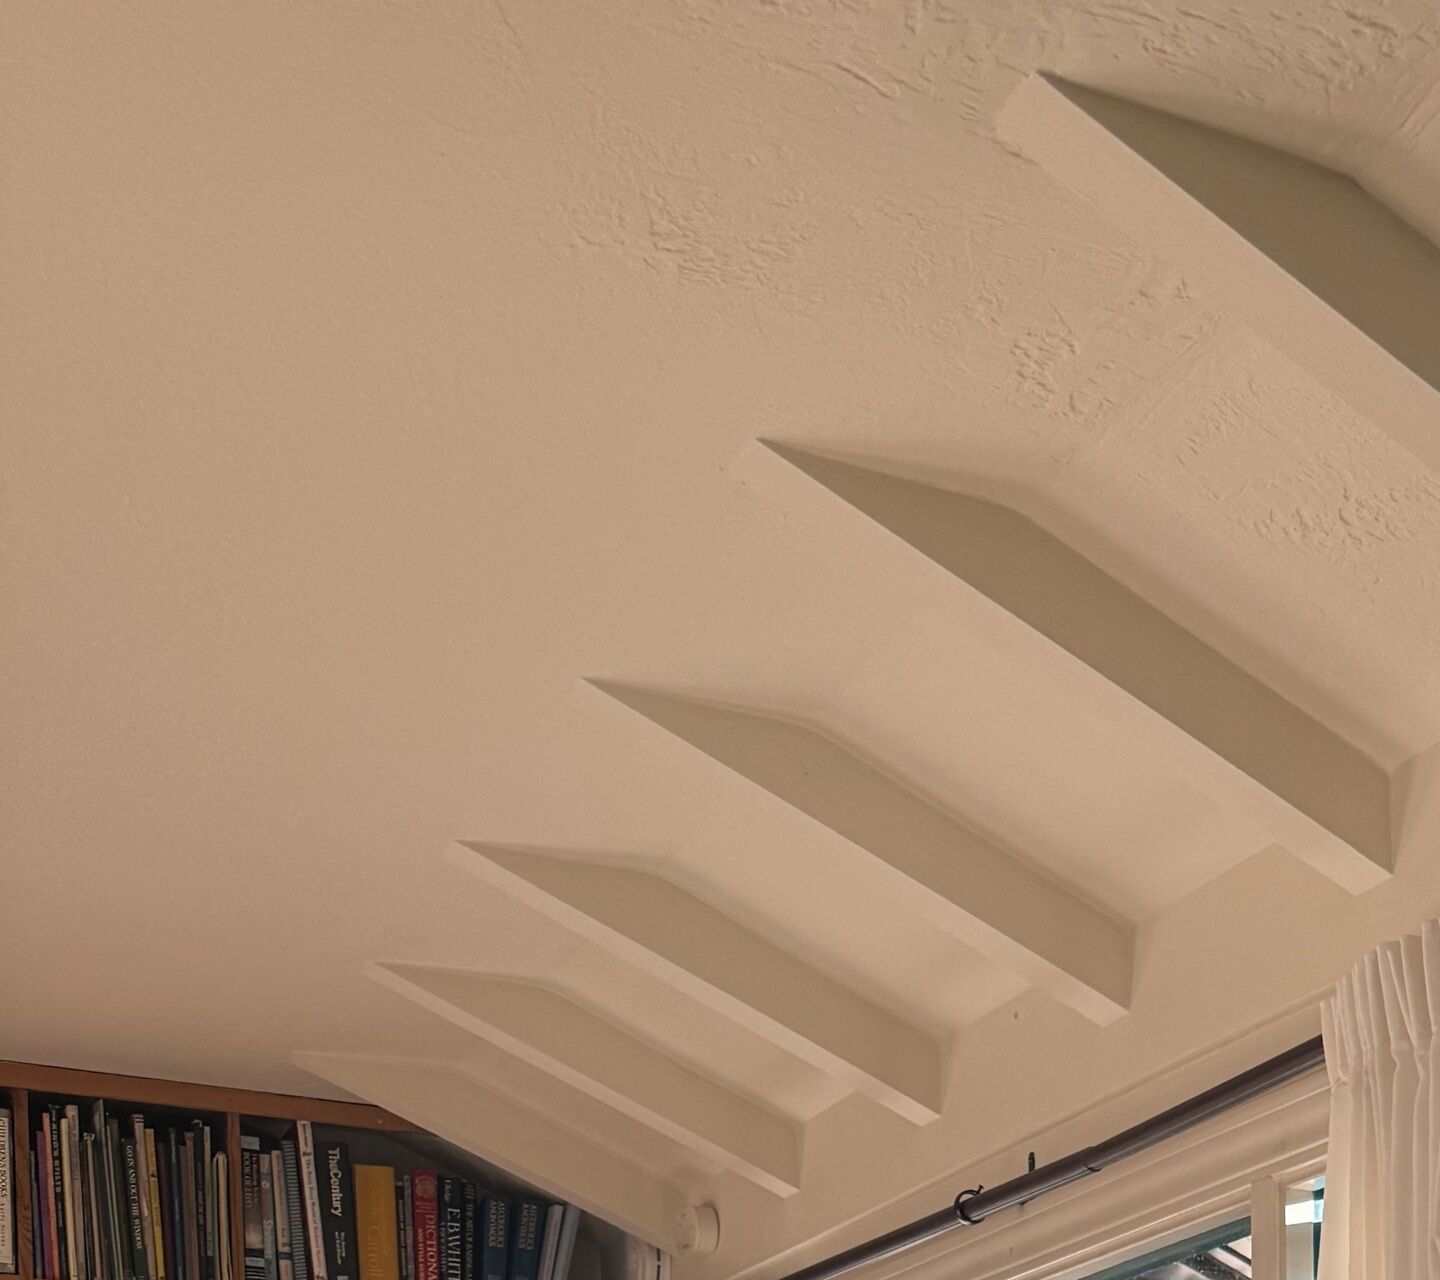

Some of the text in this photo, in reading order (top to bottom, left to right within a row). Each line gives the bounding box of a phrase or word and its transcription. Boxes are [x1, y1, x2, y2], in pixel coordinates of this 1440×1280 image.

[132, 1219, 142, 1250] WINDOW
[488, 1200, 497, 1248] ANONYMOUS
[496, 1201, 506, 1249] ALCOHOLICS
[518, 1203, 529, 1249] ANONYMOUS
[527, 1204, 538, 1250] ALCOHOLICS
